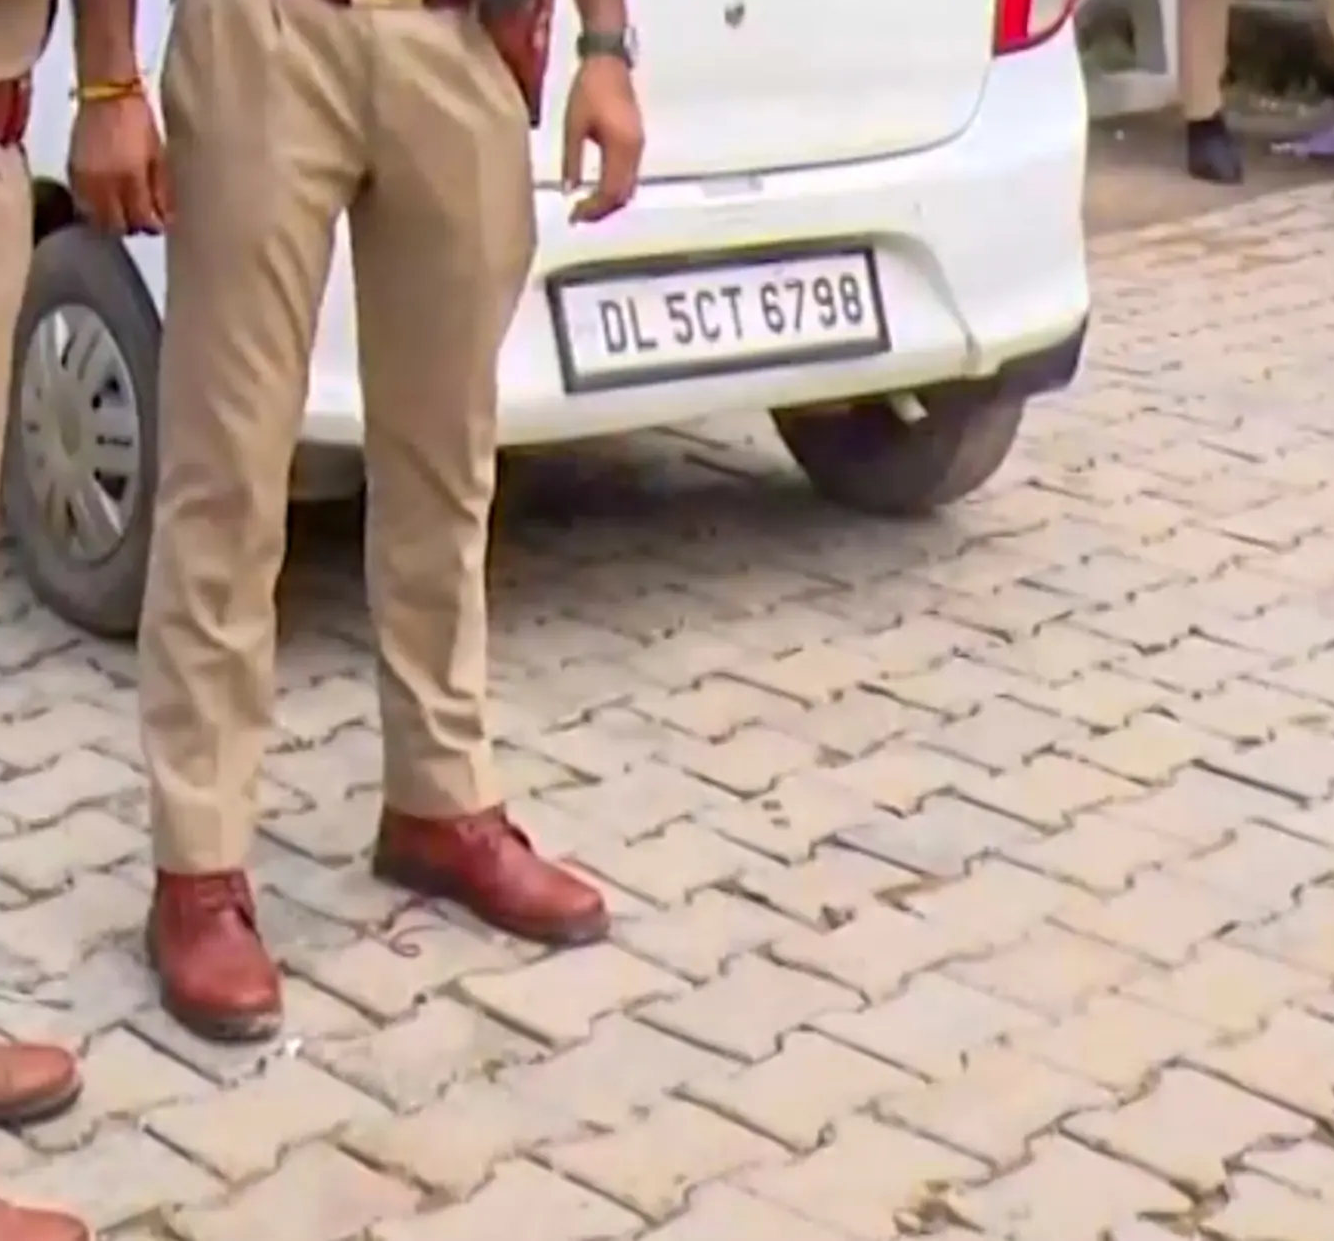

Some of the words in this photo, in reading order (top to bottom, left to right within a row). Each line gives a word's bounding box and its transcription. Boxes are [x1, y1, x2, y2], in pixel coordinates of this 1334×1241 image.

[598, 298, 658, 355] DL
[665, 286, 743, 346] 5CT
[760, 273, 864, 335] 6798
